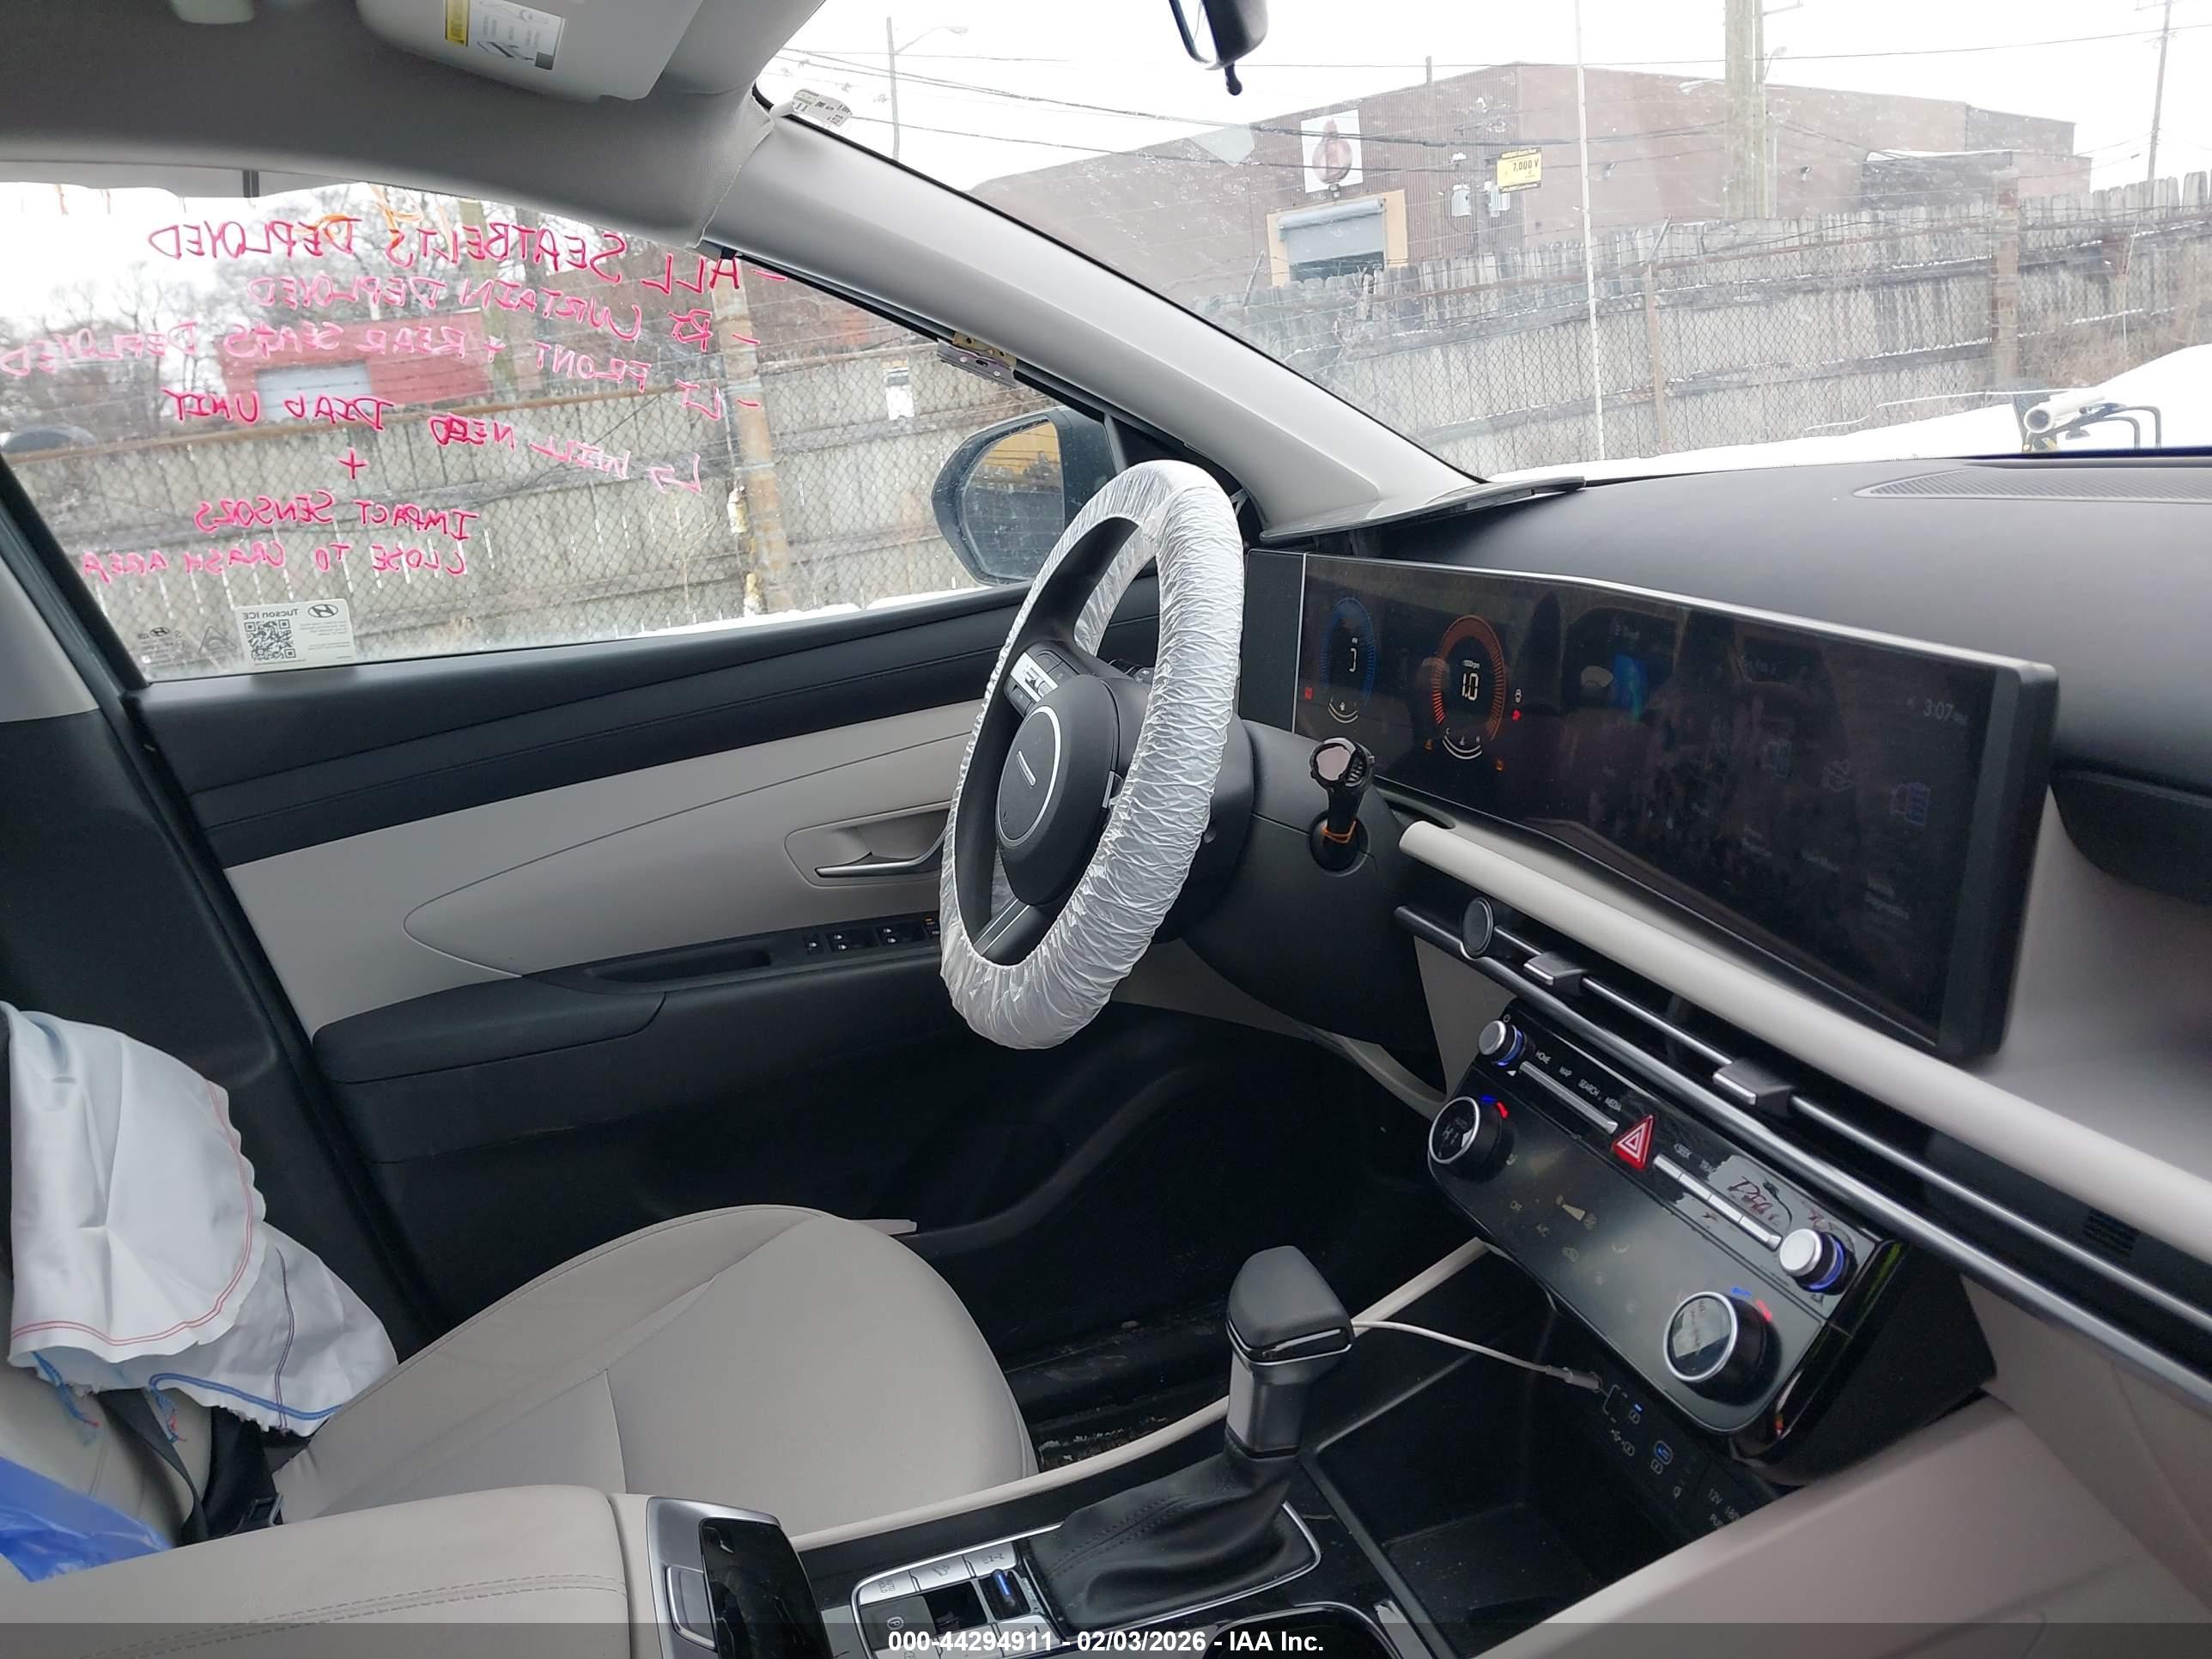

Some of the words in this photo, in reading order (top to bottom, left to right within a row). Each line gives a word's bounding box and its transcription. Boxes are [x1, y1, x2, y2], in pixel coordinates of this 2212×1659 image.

[1535, 1050, 1552, 1065] HOME
[1559, 1066, 1572, 1078] MAP
[1578, 1079, 1601, 1096] SEARCH
[1605, 1097, 1622, 1112] MEDIA
